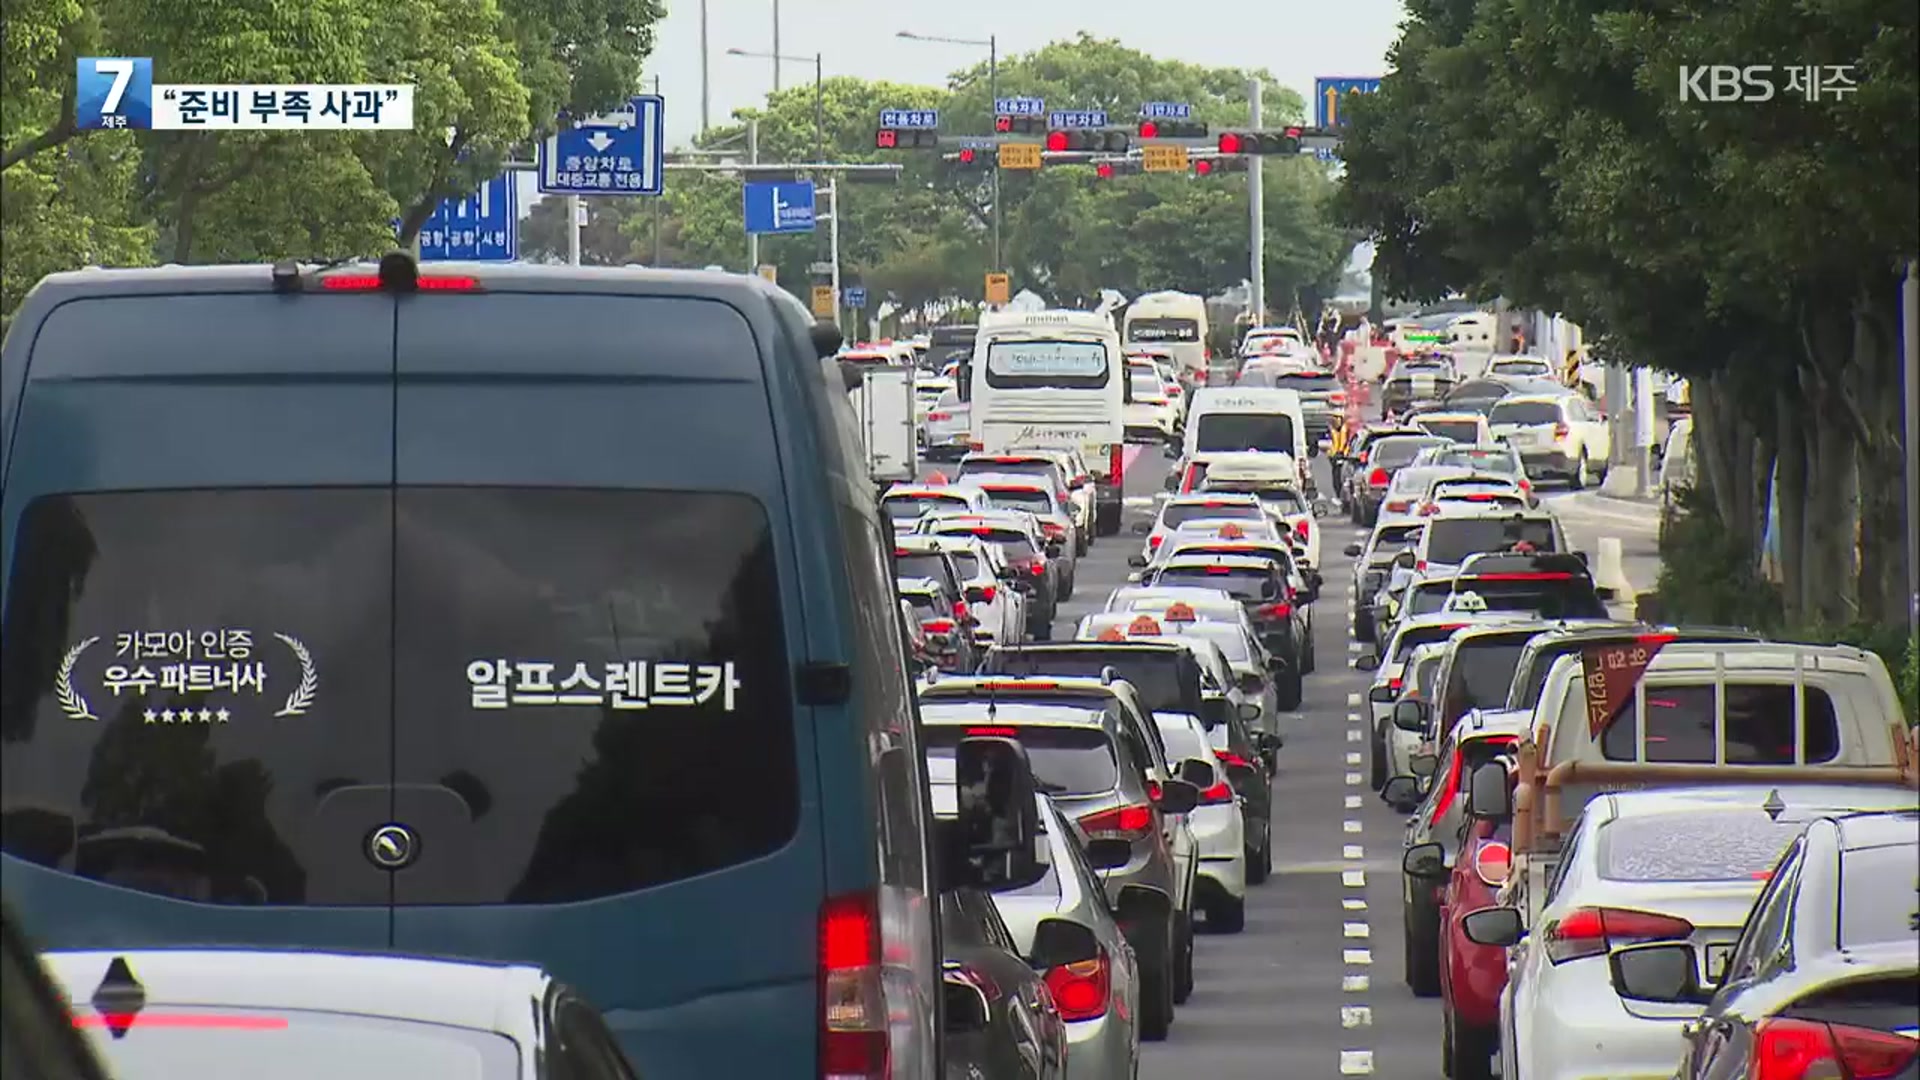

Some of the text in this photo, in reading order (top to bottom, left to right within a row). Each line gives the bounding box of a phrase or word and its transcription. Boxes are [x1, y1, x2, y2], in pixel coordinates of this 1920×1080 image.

[117, 629, 254, 660] 카모아 인증
[103, 661, 267, 696] 우수 파트너사
[466, 659, 741, 711] 알프스렌트카
